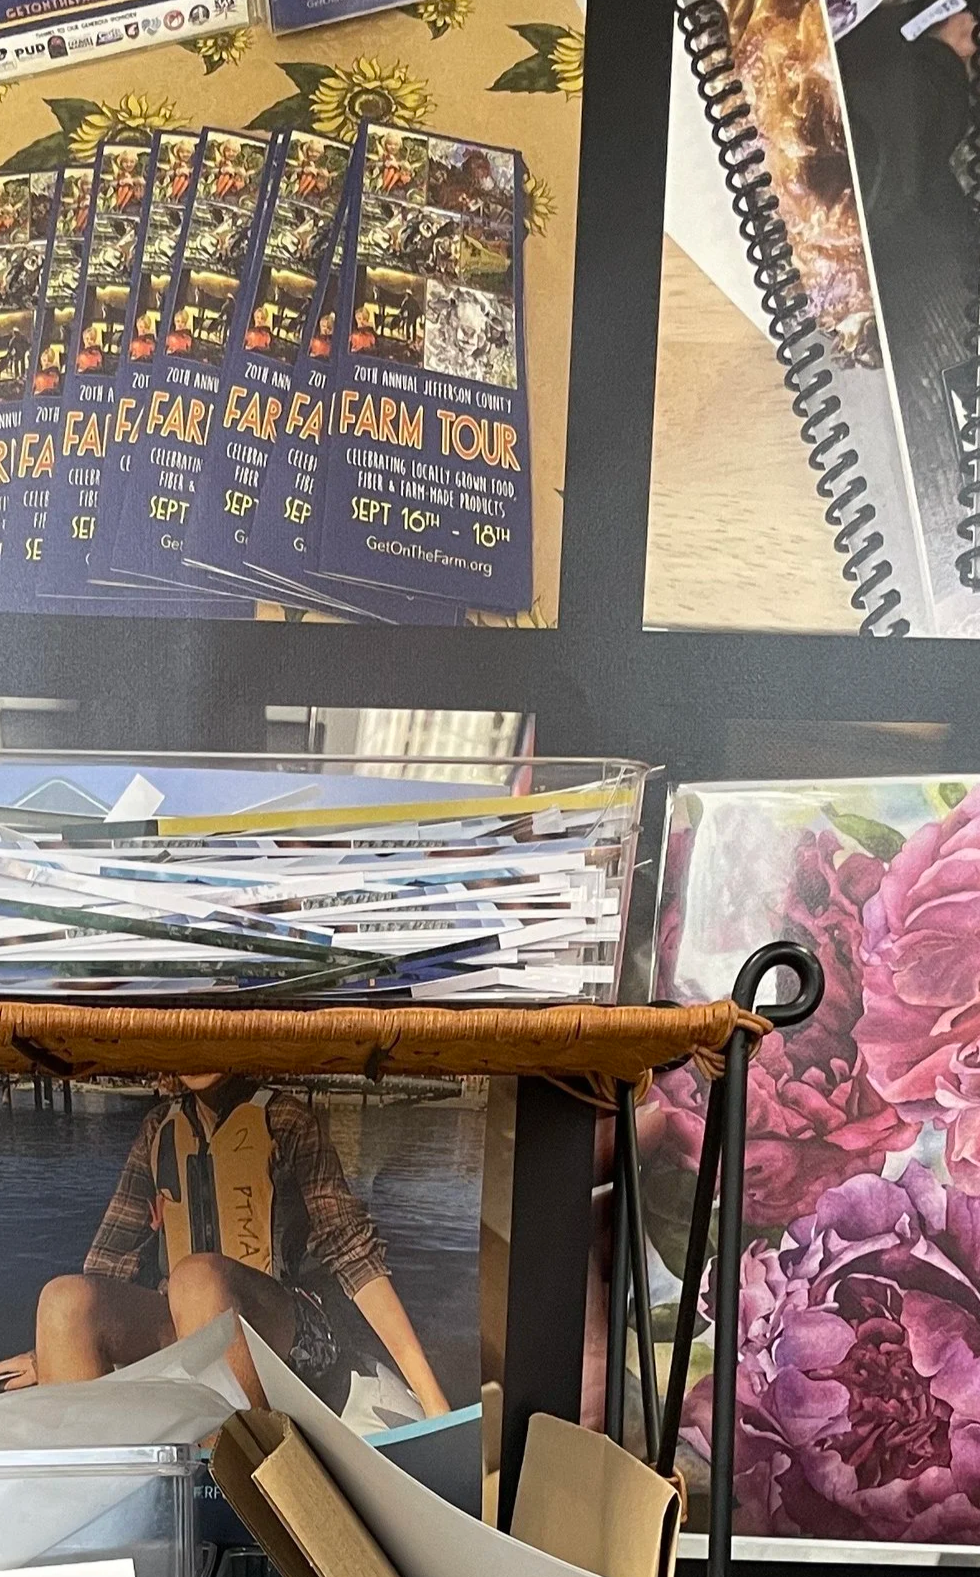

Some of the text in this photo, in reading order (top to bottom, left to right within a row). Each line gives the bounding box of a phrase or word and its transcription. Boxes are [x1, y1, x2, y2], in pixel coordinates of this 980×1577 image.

[14, 43, 45, 58] PUD
[80, 384, 103, 403] 20TH
[354, 365, 512, 414] 20TH ANNUAL JEFFERSON COUNTY
[146, 390, 215, 447] FAR
[339, 390, 521, 471] FARM TOUR
[159, 470, 184, 492] FIBER
[234, 465, 259, 487] FIBER
[346, 448, 406, 476] CELEBRATING
[411, 460, 451, 486] LOCALLY
[455, 471, 487, 493] GROWN
[149, 495, 190, 524] SEPT
[358, 470, 506, 519] FIBER & FARM-MADE PRODUCTS
[351, 496, 392, 526] SEPT
[401, 506, 441, 533] 16TH
[472, 521, 511, 548] 18TH
[366, 535, 493, 578] GetOnTheFarm.org
